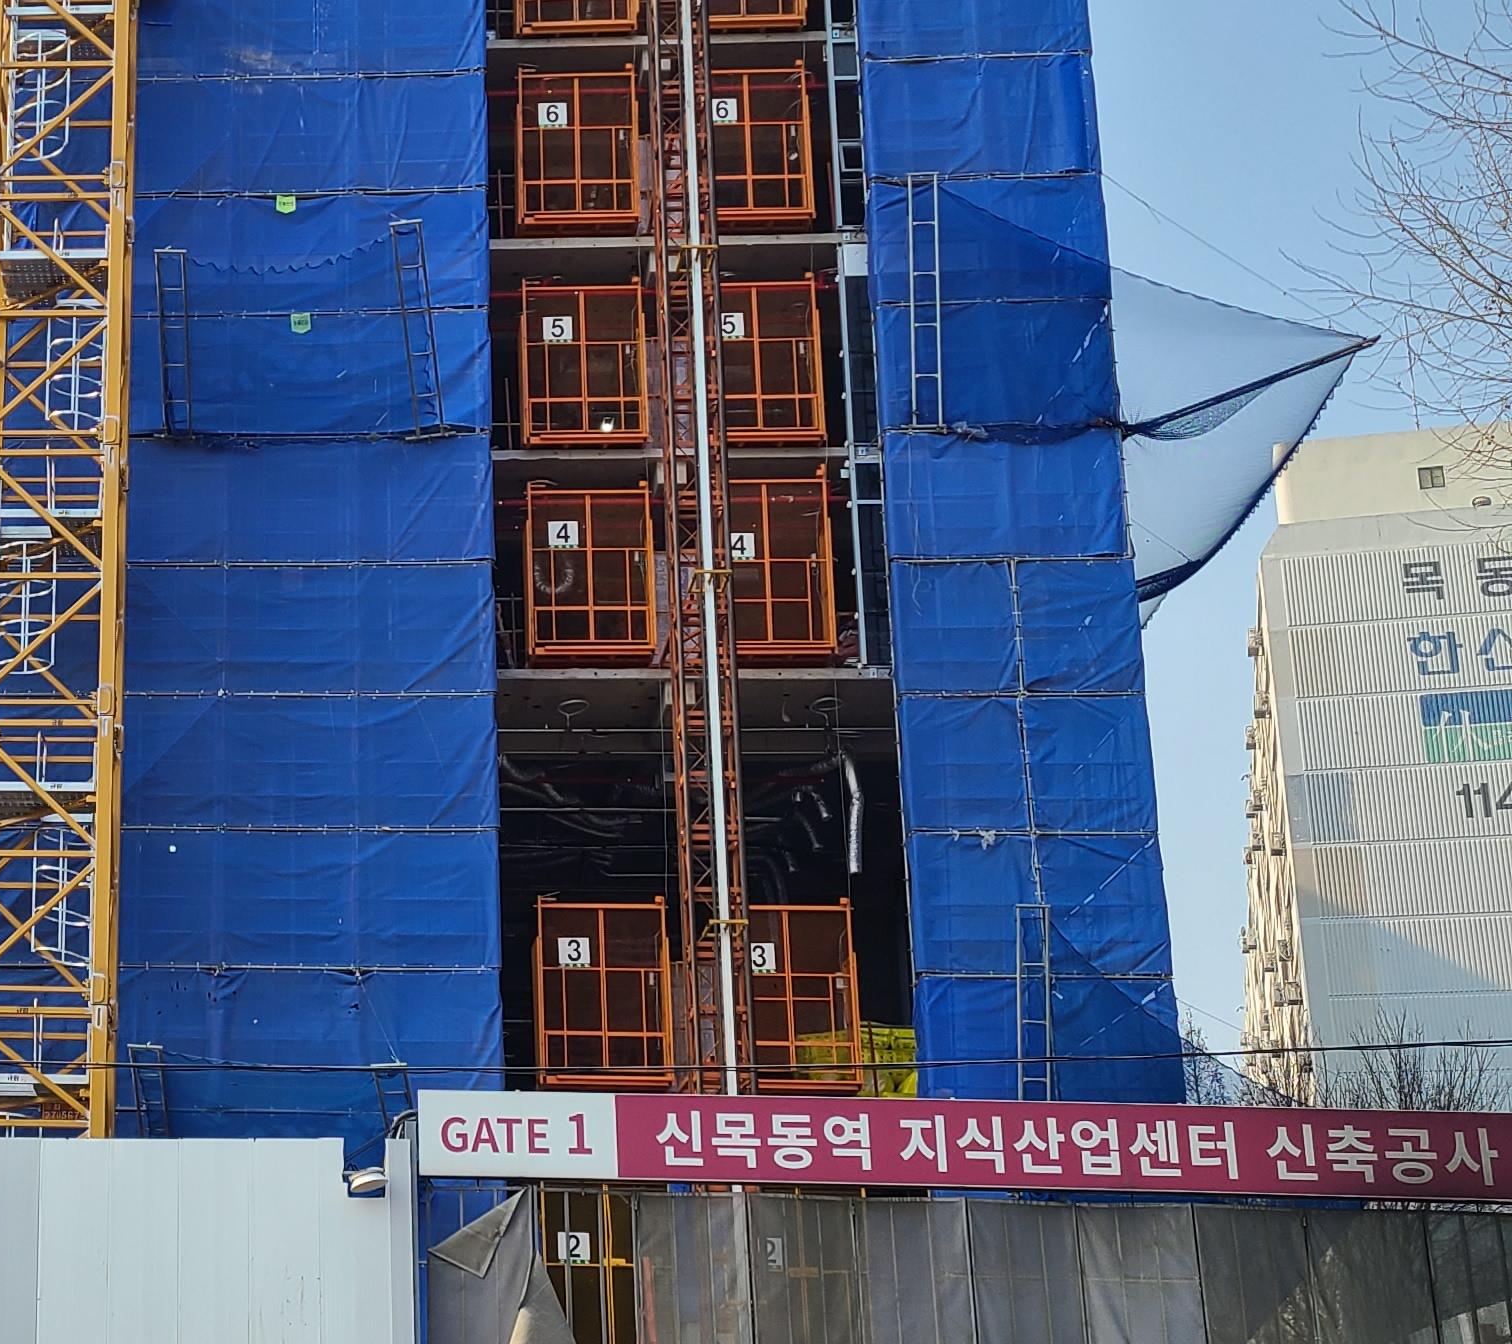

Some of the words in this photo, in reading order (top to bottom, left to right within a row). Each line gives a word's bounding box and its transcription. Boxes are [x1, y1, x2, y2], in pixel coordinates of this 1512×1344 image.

[546, 106, 559, 123] 6
[716, 102, 729, 119] 6
[550, 320, 564, 338] 5
[722, 315, 736, 335] 5
[556, 524, 571, 544] 4
[731, 536, 747, 555] 4
[567, 941, 582, 961] 3
[752, 946, 767, 967] 3
[439, 1115, 552, 1155] GATE
[568, 1112, 593, 1155] 1
[656, 1110, 872, 1171] 신목동역
[899, 1114, 1240, 1180] 지식산업센터
[1266, 1122, 1499, 1187] 신축공사
[568, 1237, 581, 1258] 2
